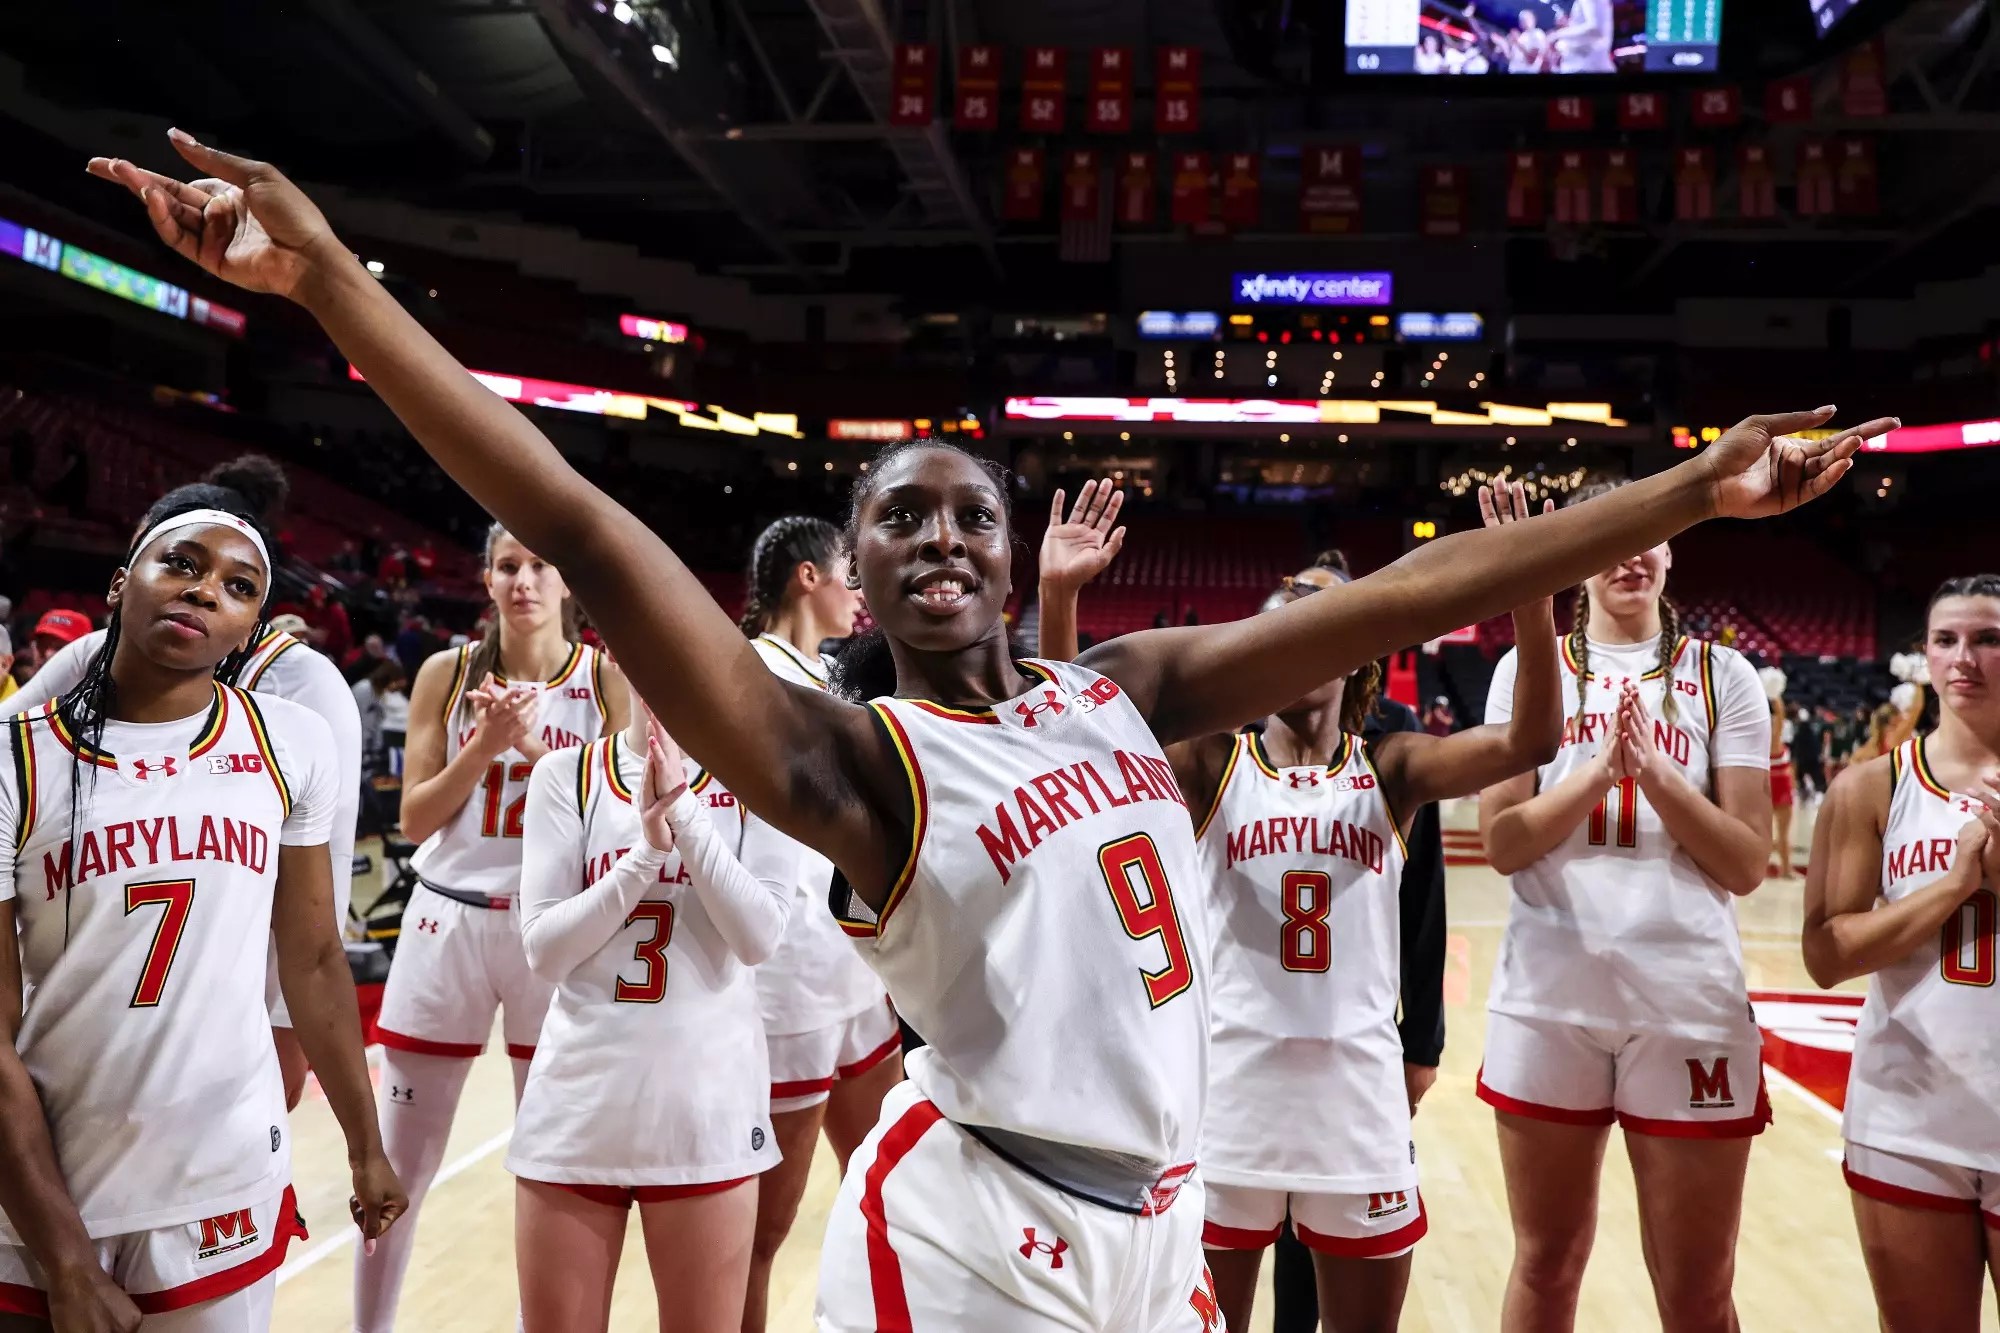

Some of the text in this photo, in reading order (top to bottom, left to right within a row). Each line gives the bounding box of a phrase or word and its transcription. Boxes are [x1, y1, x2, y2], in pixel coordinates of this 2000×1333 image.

[1240, 273, 1383, 302] xfinity center
[480, 760, 535, 838] 12
[975, 750, 1188, 886] MARYLAND
[1226, 816, 1384, 875] MARYLAND
[43, 815, 268, 901] MARYLAND
[124, 878, 196, 1008] 7
[614, 900, 674, 1003] 3
[1097, 831, 1194, 1011] 9
[1280, 869, 1332, 973] 8
[1940, 888, 1997, 988] 0
[1685, 1056, 1734, 1102] M
[199, 1207, 259, 1251] M
